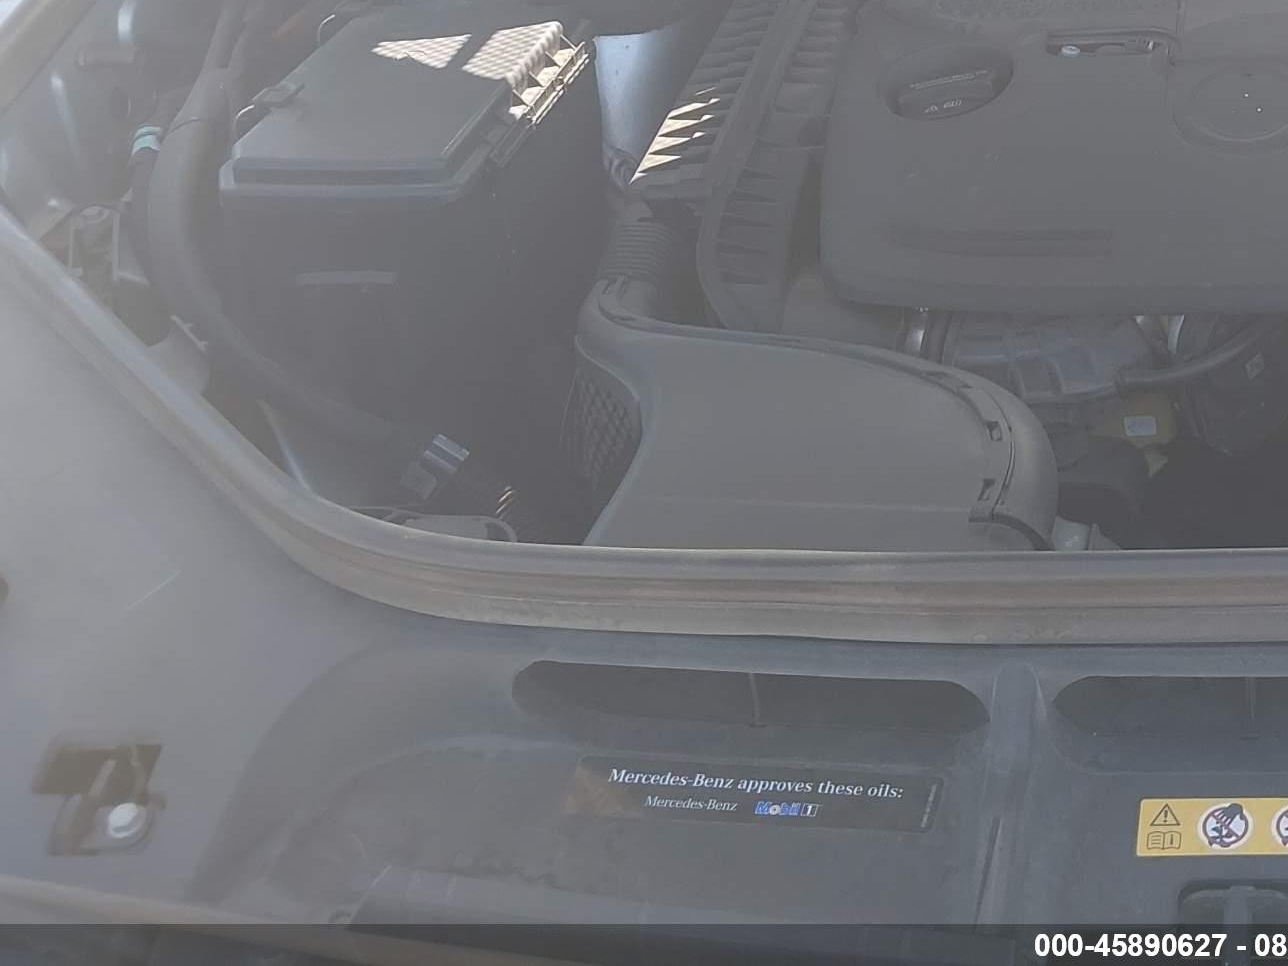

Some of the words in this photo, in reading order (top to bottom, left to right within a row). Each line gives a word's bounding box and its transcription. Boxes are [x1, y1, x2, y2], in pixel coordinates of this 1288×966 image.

[608, 769, 734, 789] Mercedes-Benz
[737, 778, 813, 794] approves
[818, 781, 863, 795] these
[867, 784, 904, 798] oils:
[645, 795, 738, 811] Mercedes-Benz
[754, 800, 801, 816] Mobil
